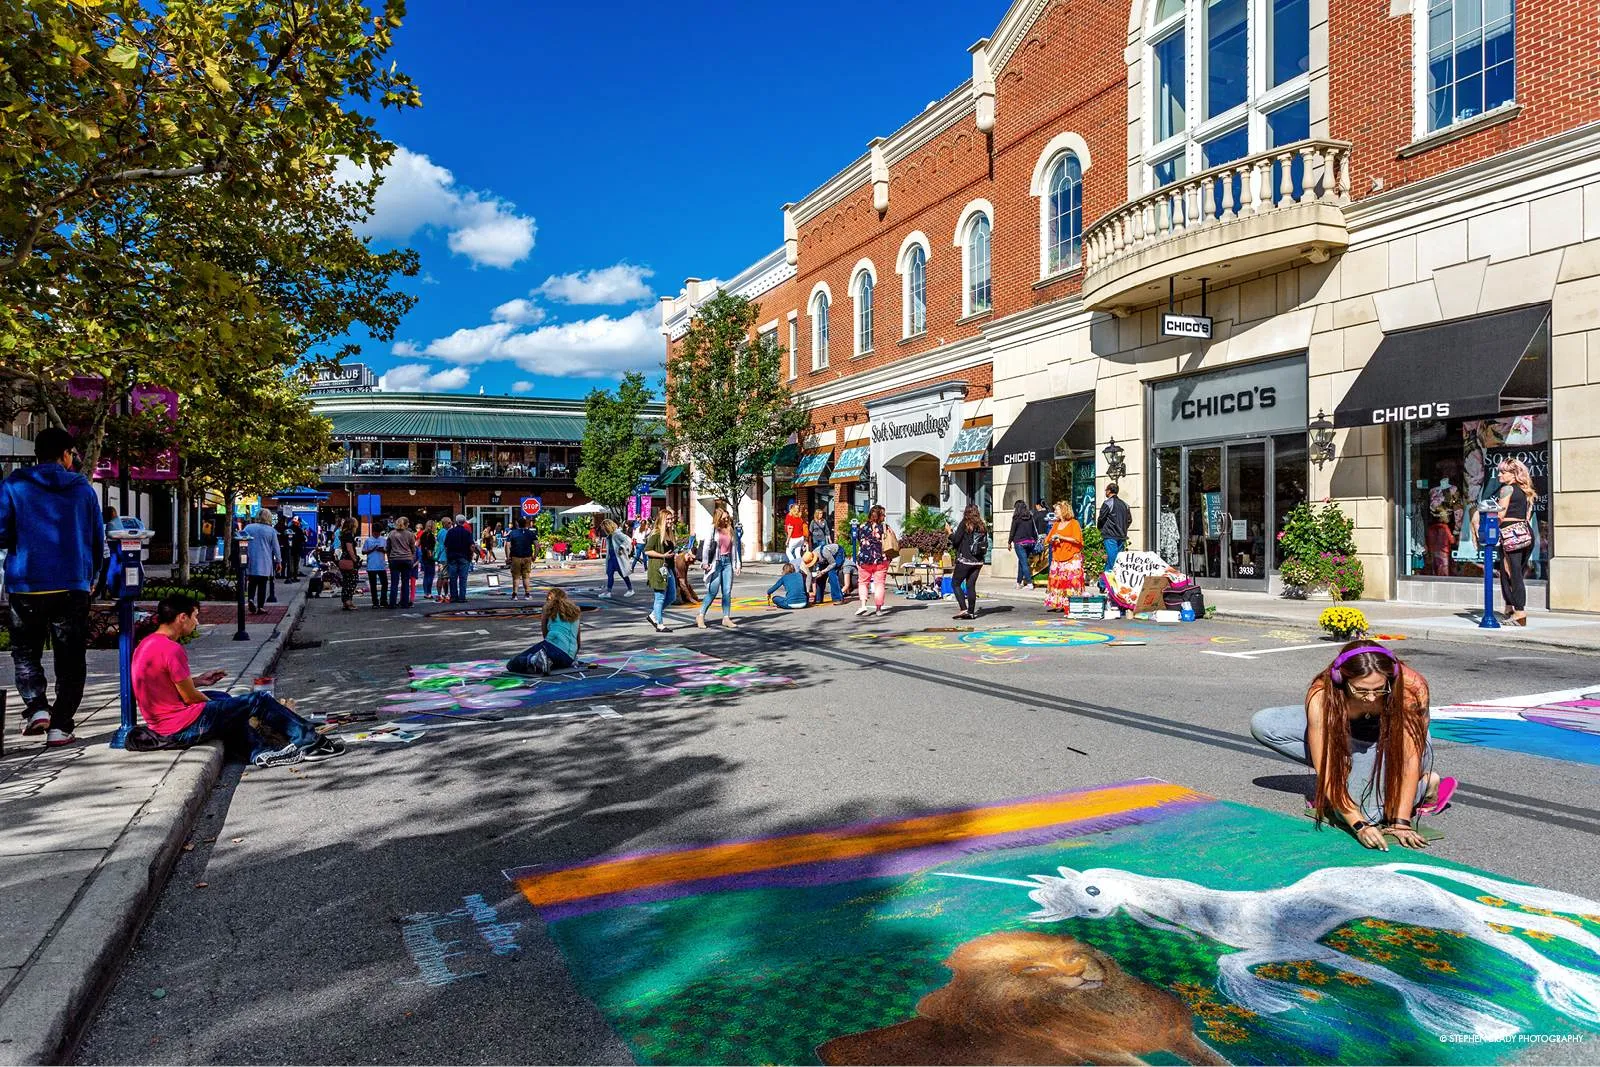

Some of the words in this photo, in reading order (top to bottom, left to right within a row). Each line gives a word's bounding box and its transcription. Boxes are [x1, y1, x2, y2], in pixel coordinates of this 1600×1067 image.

[1166, 320, 1209, 333] CHICO'S
[297, 371, 331, 382] OCAN
[1181, 386, 1276, 419] CHICO'S
[1372, 402, 1450, 423] CHICO'S
[871, 421, 888, 443] Soft
[888, 412, 950, 440] Surroundings
[1003, 451, 1036, 464] CHICO'S
[1484, 453, 1503, 466] SO
[1507, 450, 1548, 463] ONG
[1125, 552, 1151, 565] Here
[1238, 566, 1254, 575] 3938
